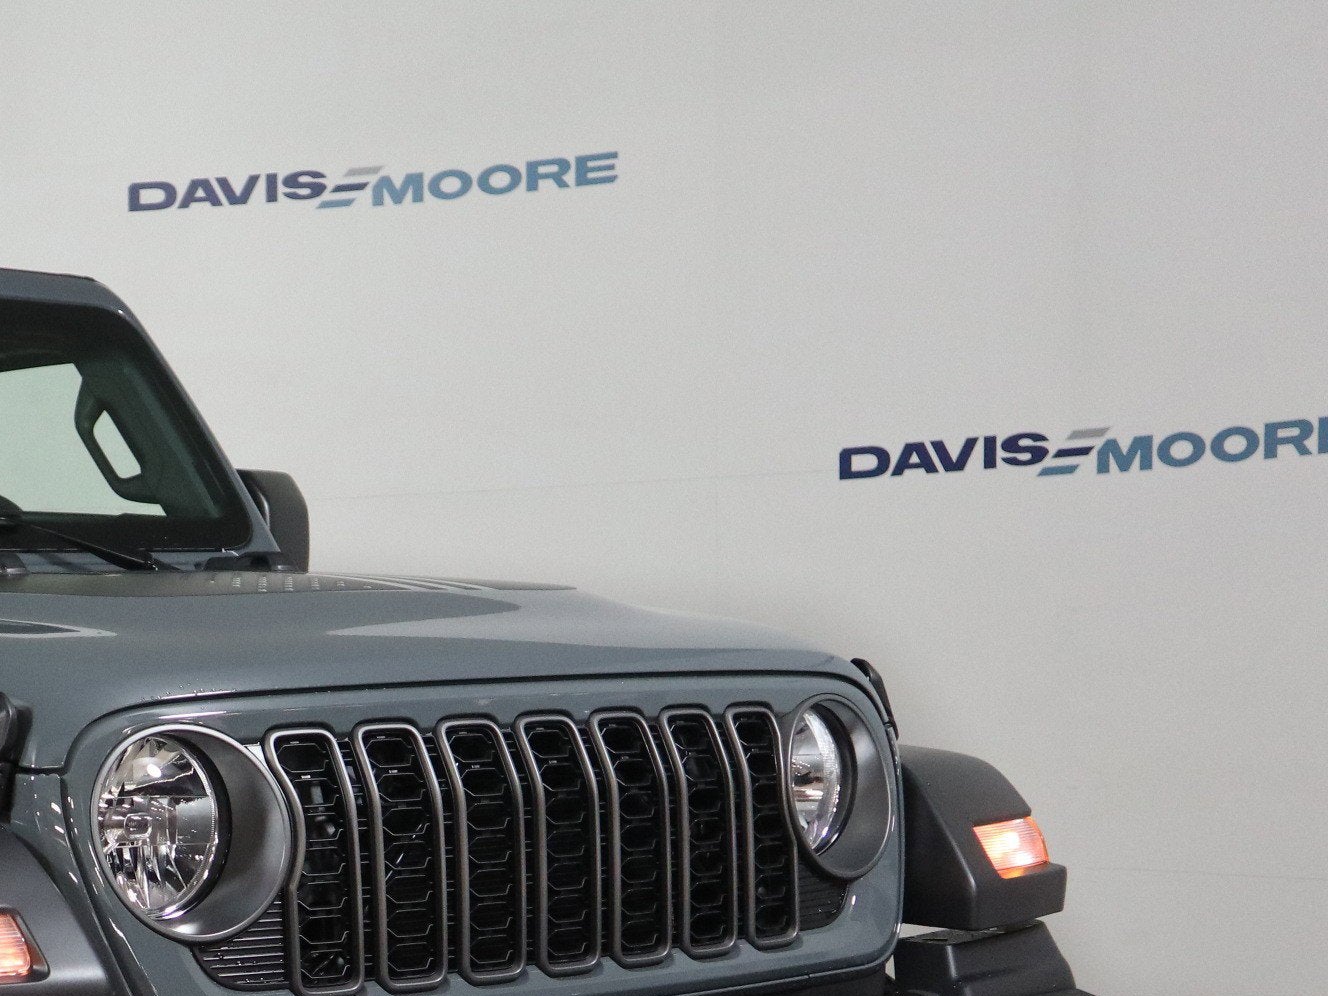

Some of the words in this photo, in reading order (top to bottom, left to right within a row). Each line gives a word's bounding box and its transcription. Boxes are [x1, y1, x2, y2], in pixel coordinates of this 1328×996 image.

[127, 169, 328, 212] DAVIS
[372, 150, 619, 207] MOORE
[838, 431, 1051, 481] DAVIS
[1096, 415, 1328, 475] MOOR
